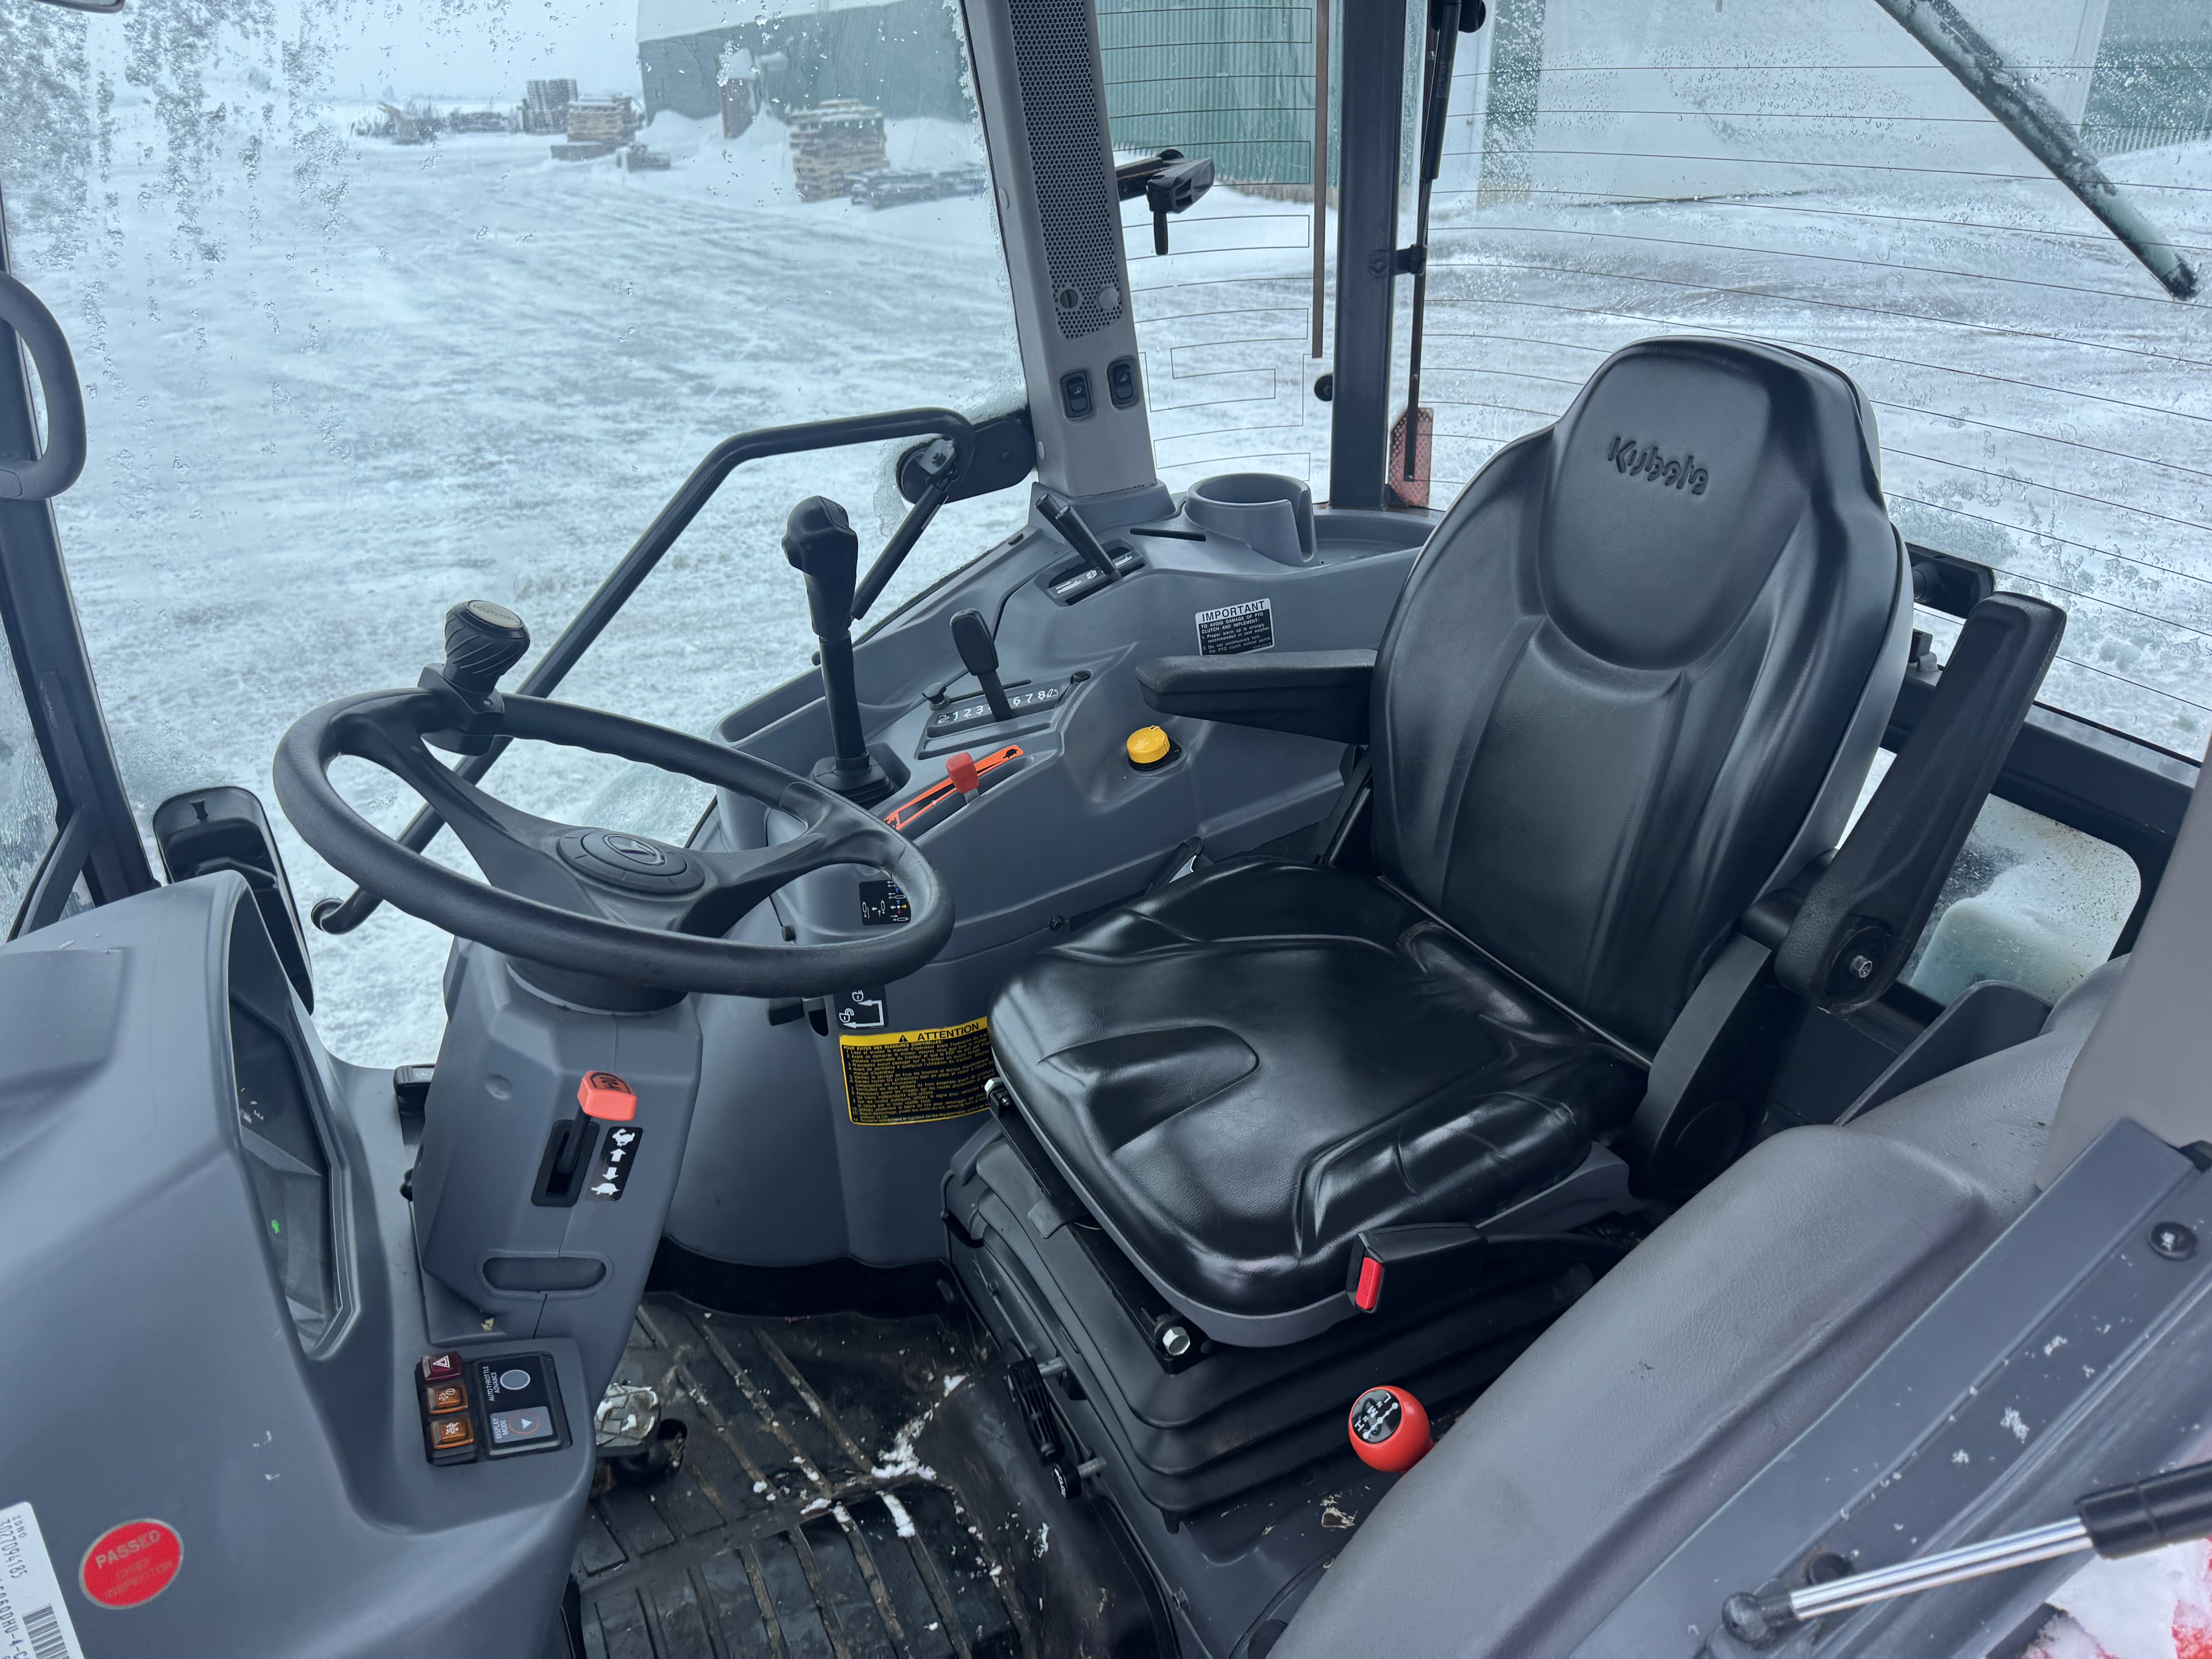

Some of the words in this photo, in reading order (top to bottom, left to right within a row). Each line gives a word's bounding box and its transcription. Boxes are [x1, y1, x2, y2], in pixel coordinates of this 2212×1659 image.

[1607, 437, 1708, 495] Kubota
[1202, 601, 1264, 622] IMPORTANT
[964, 708, 971, 716] 2
[976, 705, 984, 713] 3
[1026, 693, 1033, 702] 7
[1038, 691, 1046, 699] 8
[918, 1022, 979, 1041] ATTENTION
[491, 1372, 500, 1393] ADVANCE
[1384, 1393, 1391, 1403] L
[493, 1418, 502, 1439] DISPLAY
[1354, 1420, 1364, 1431] H
[12, 1515, 27, 1538] IDNO
[96, 1530, 160, 1569] PASSED
